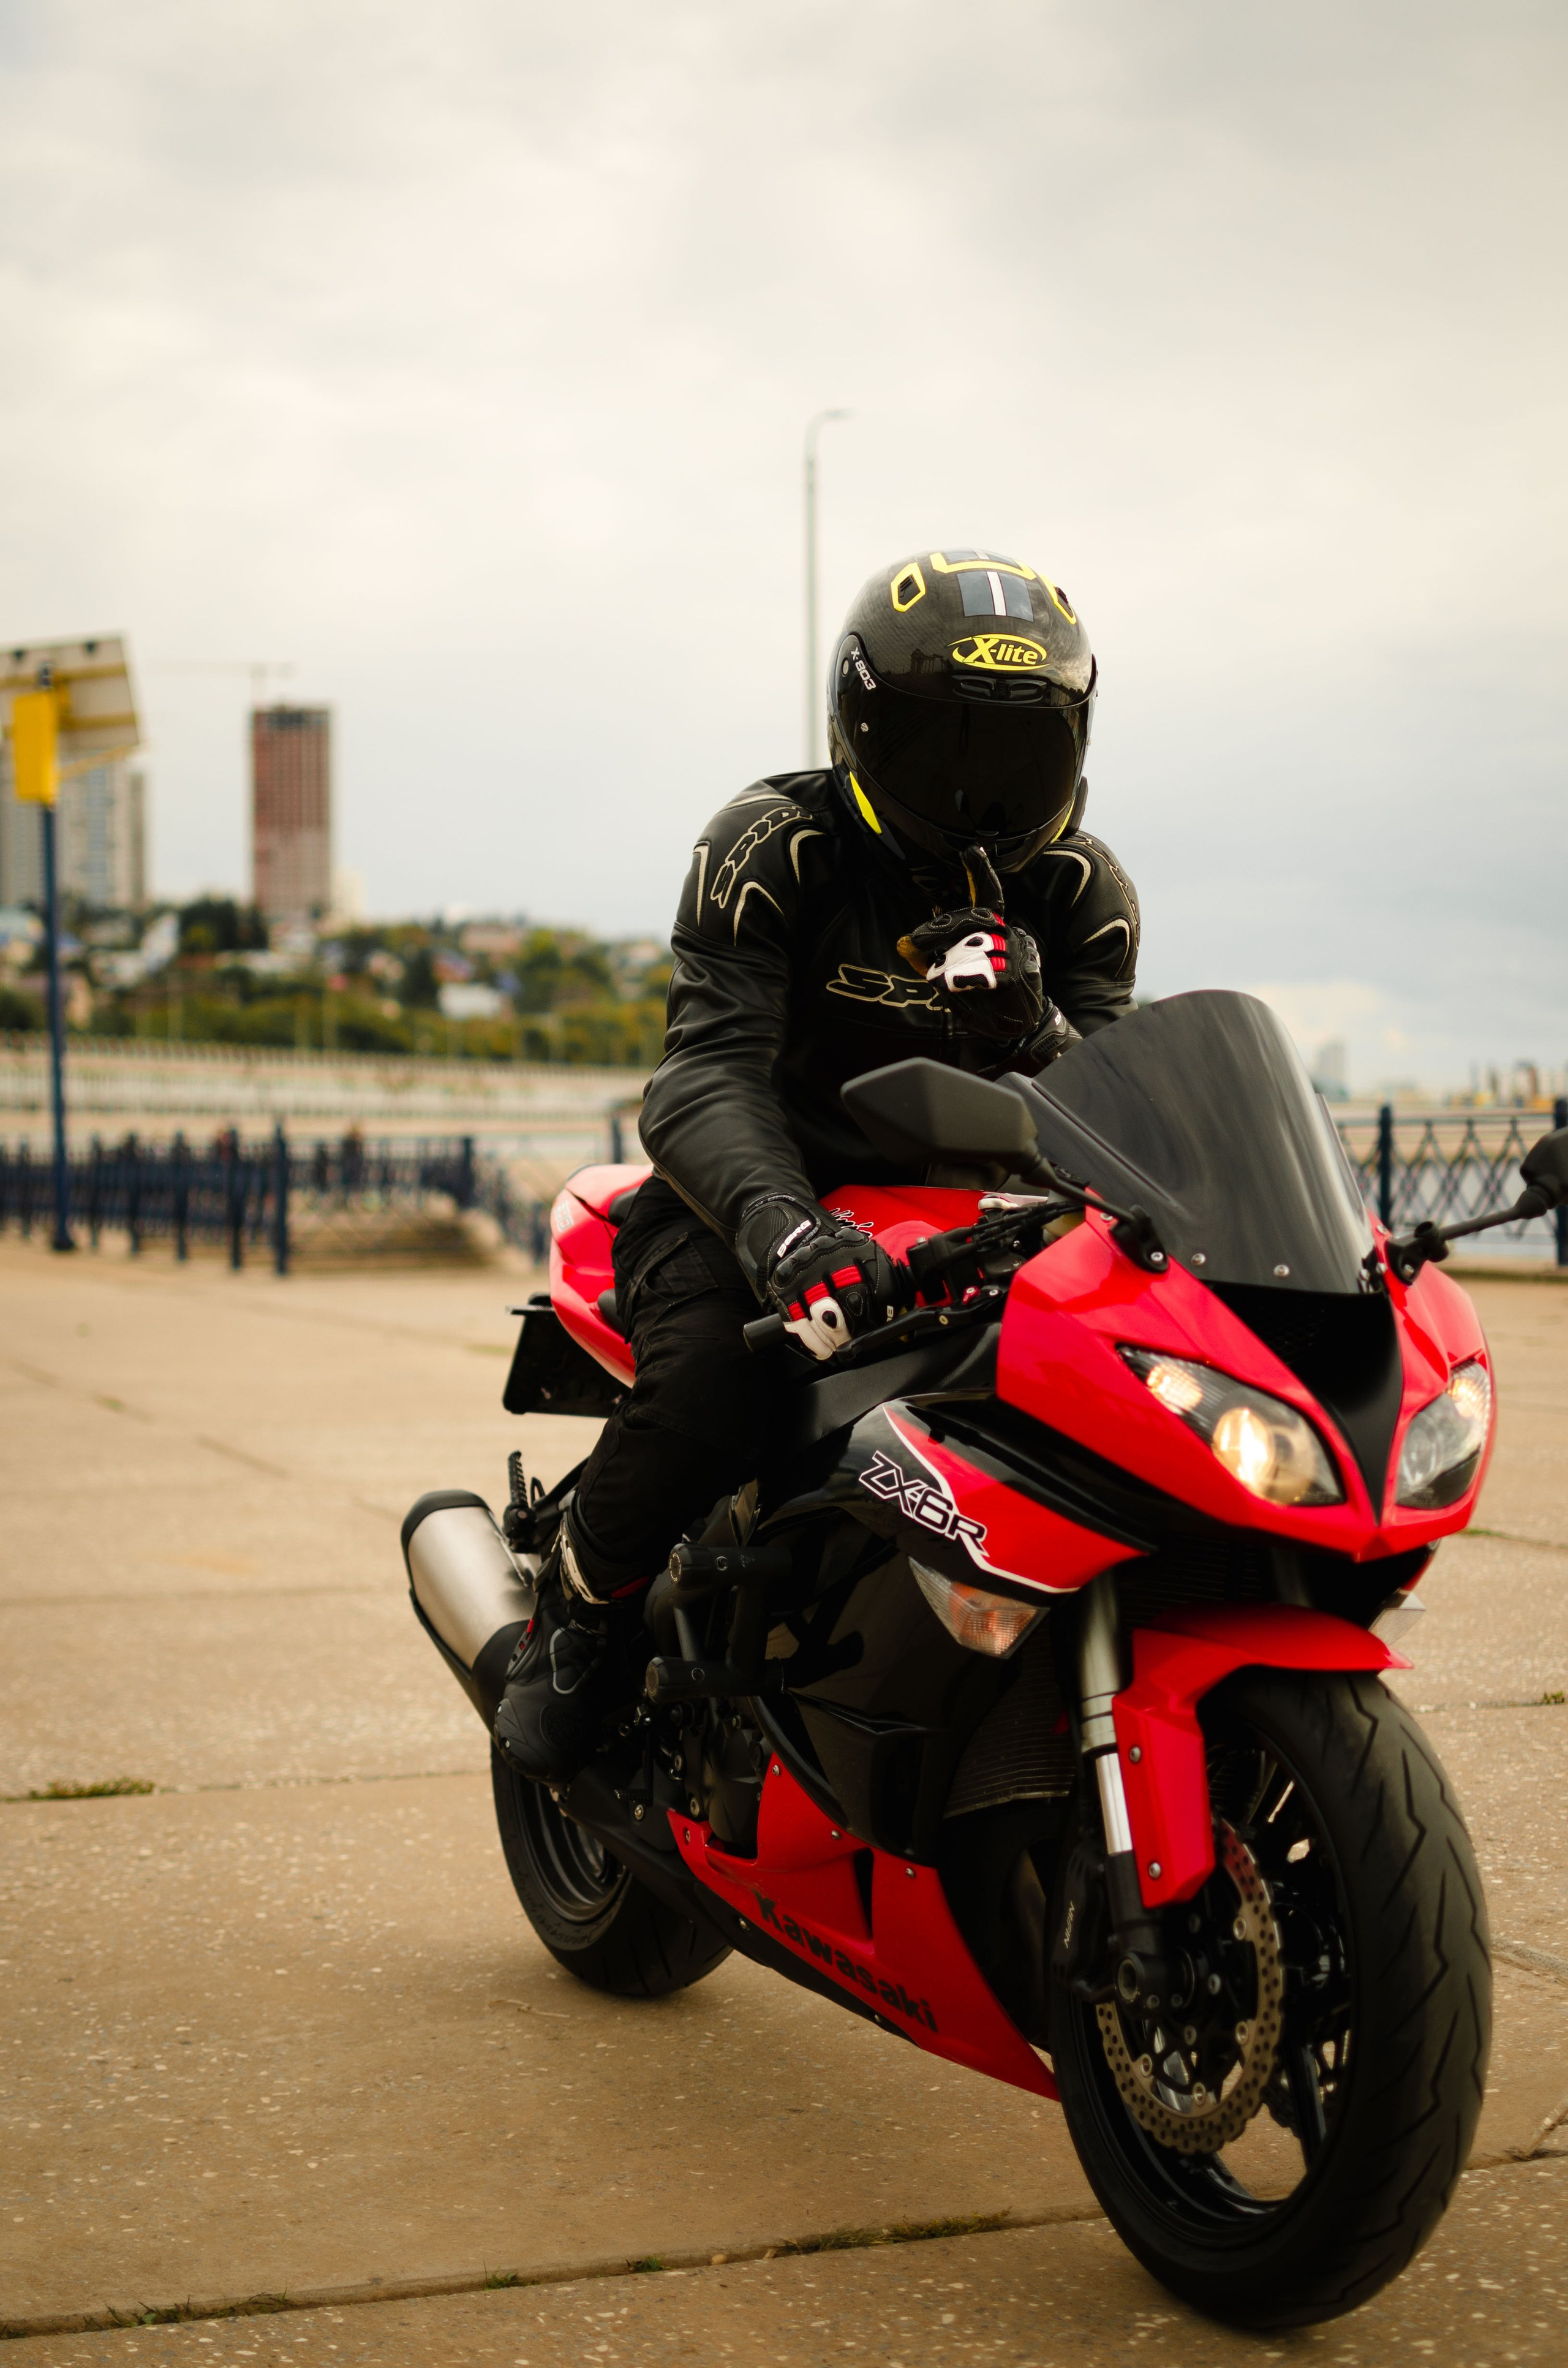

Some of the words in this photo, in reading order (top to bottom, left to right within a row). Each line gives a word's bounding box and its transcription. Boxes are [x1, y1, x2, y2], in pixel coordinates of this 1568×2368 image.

[851, 646, 876, 690] X-803
[963, 637, 1039, 665] X-lite
[859, 1450, 990, 1558] ZX-6R
[752, 1888, 938, 2033] Kawasaki
